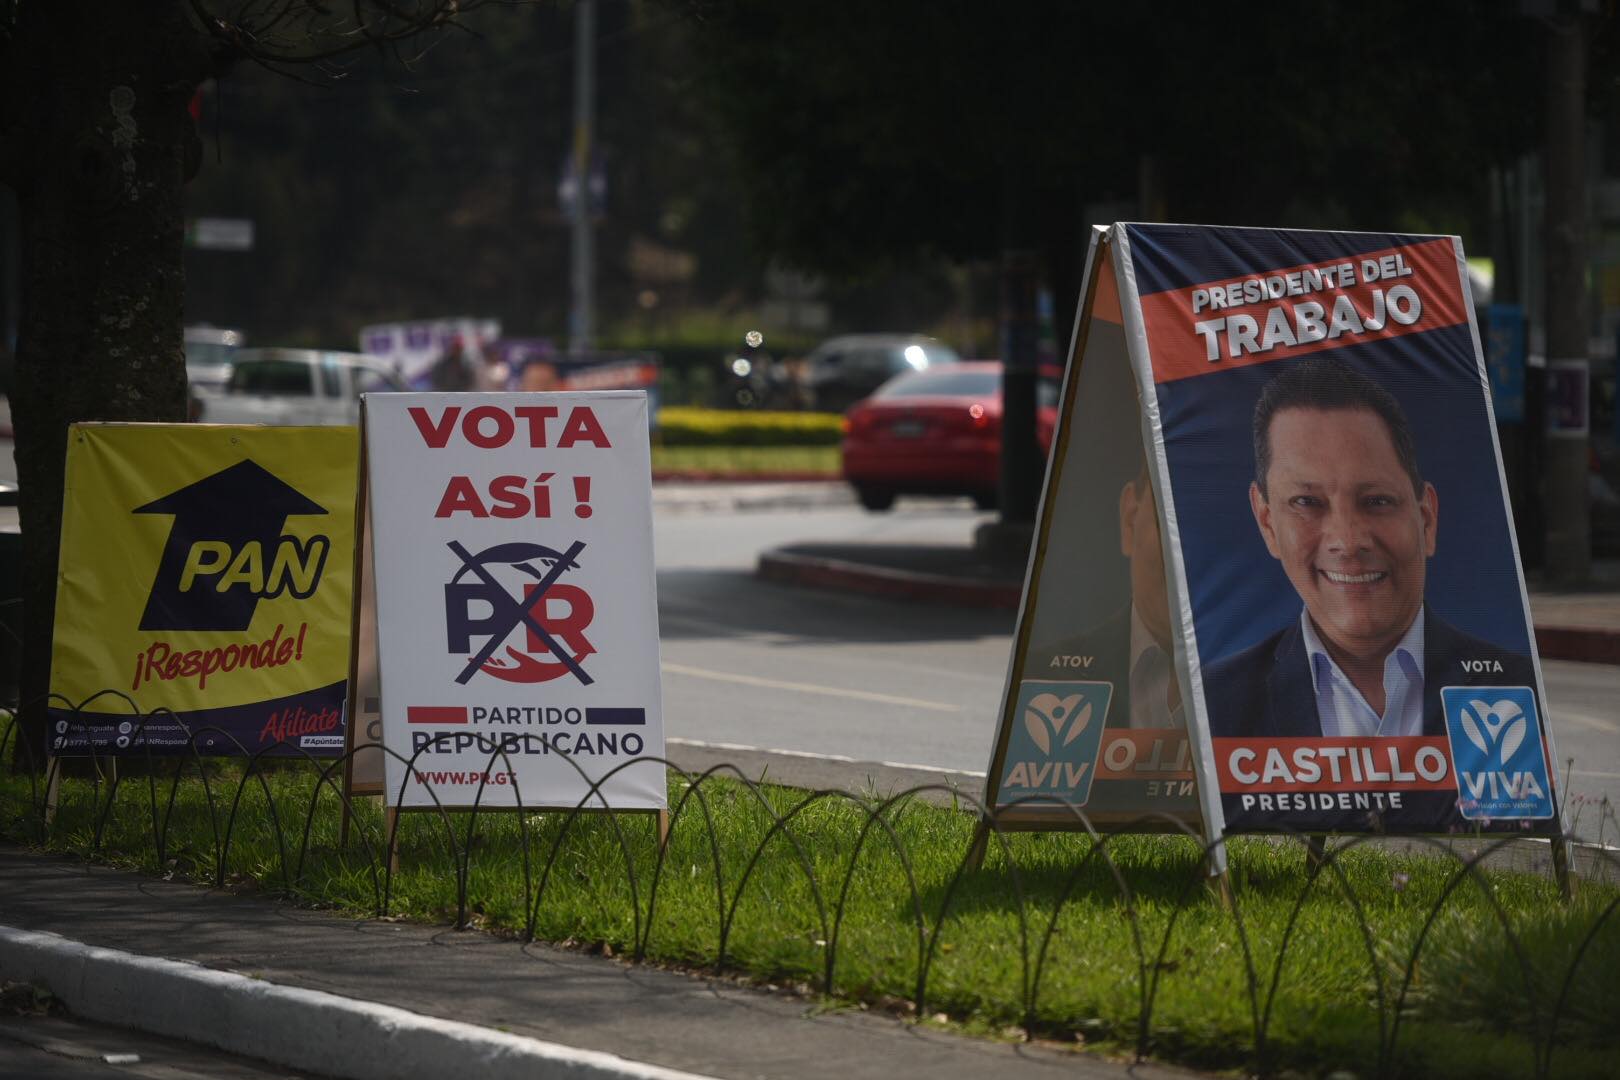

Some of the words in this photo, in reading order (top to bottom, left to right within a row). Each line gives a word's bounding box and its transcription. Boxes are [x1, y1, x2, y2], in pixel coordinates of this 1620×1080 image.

[1192, 263, 1356, 314] PRESIDENTE
[1361, 254, 1412, 283] DEL
[1195, 284, 1422, 361] TRABAJO
[407, 406, 612, 449] VOTA
[573, 476, 593, 519] !
[178, 538, 328, 596] PAN
[444, 584, 597, 654] PR
[132, 623, 307, 690] ¡Responde!
[1461, 660, 1504, 673] VOTA
[472, 707, 582, 725] PARTIDO
[412, 731, 644, 756] REPUBLICANO
[414, 771, 517, 785] WWW.PR.GT
[1229, 746, 1448, 784] CASTILLO
[1241, 792, 1403, 812] PRESIDENTE
[1461, 771, 1545, 800] VIVA
